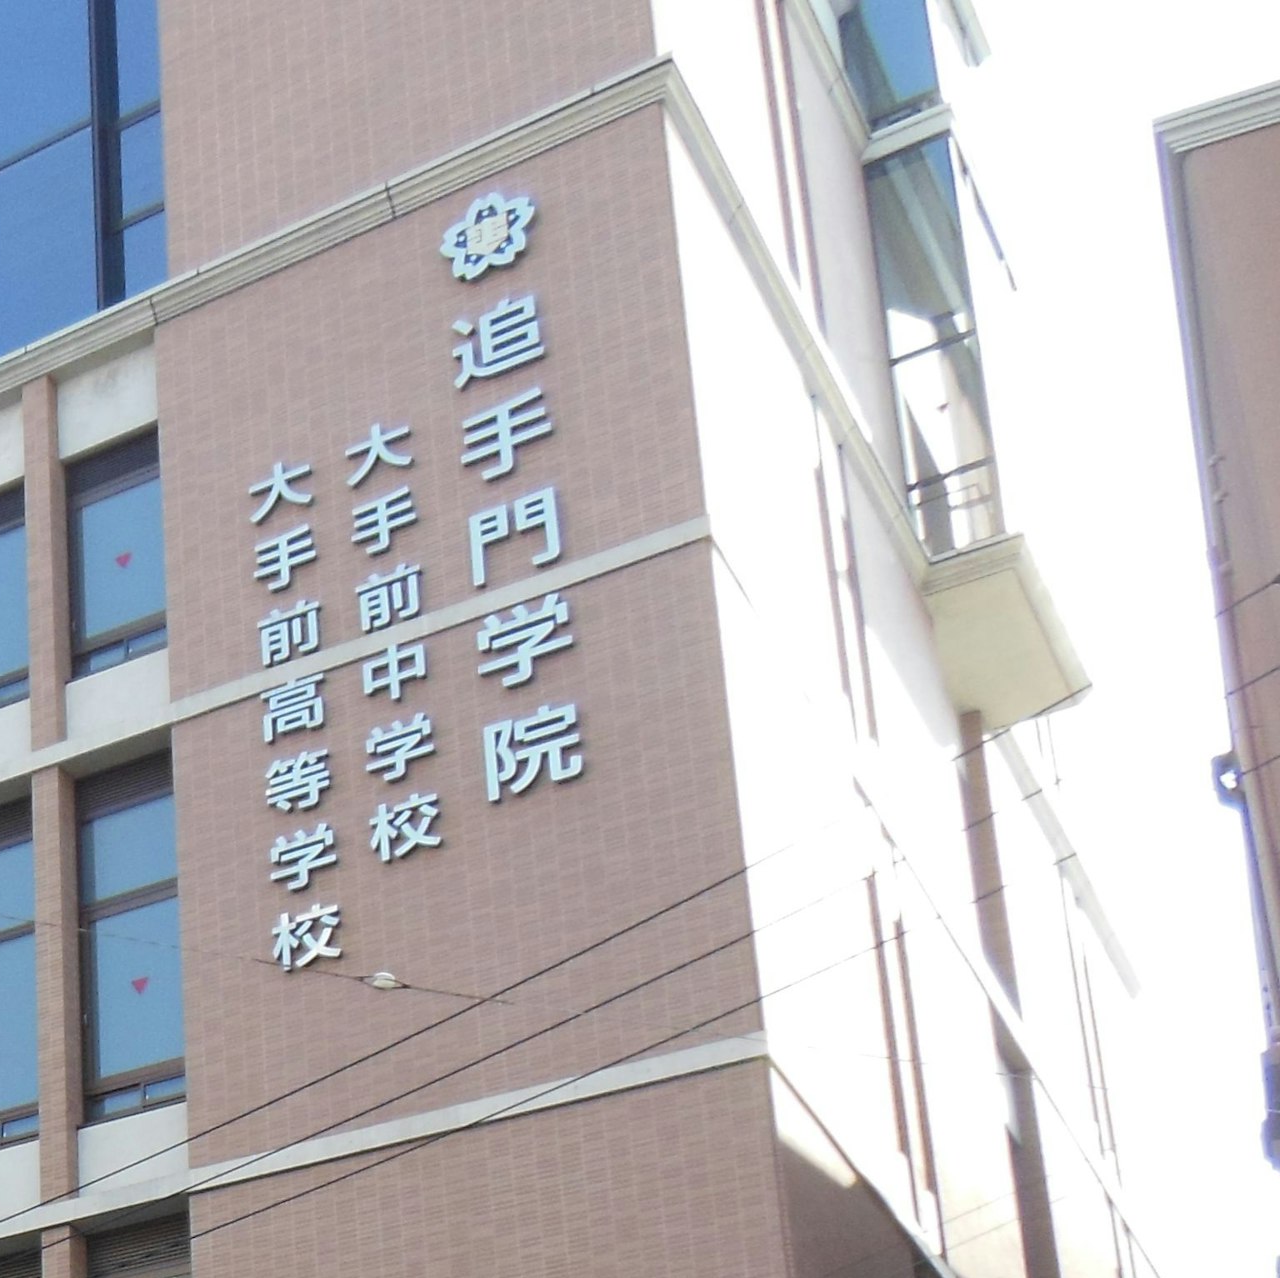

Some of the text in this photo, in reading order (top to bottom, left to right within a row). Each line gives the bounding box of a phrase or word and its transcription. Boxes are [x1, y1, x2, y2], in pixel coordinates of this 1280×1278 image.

[249, 462, 342, 971] 大手前高等学校
[346, 423, 441, 862] 大手前中学校
[452, 297, 583, 804] 追手門学院
